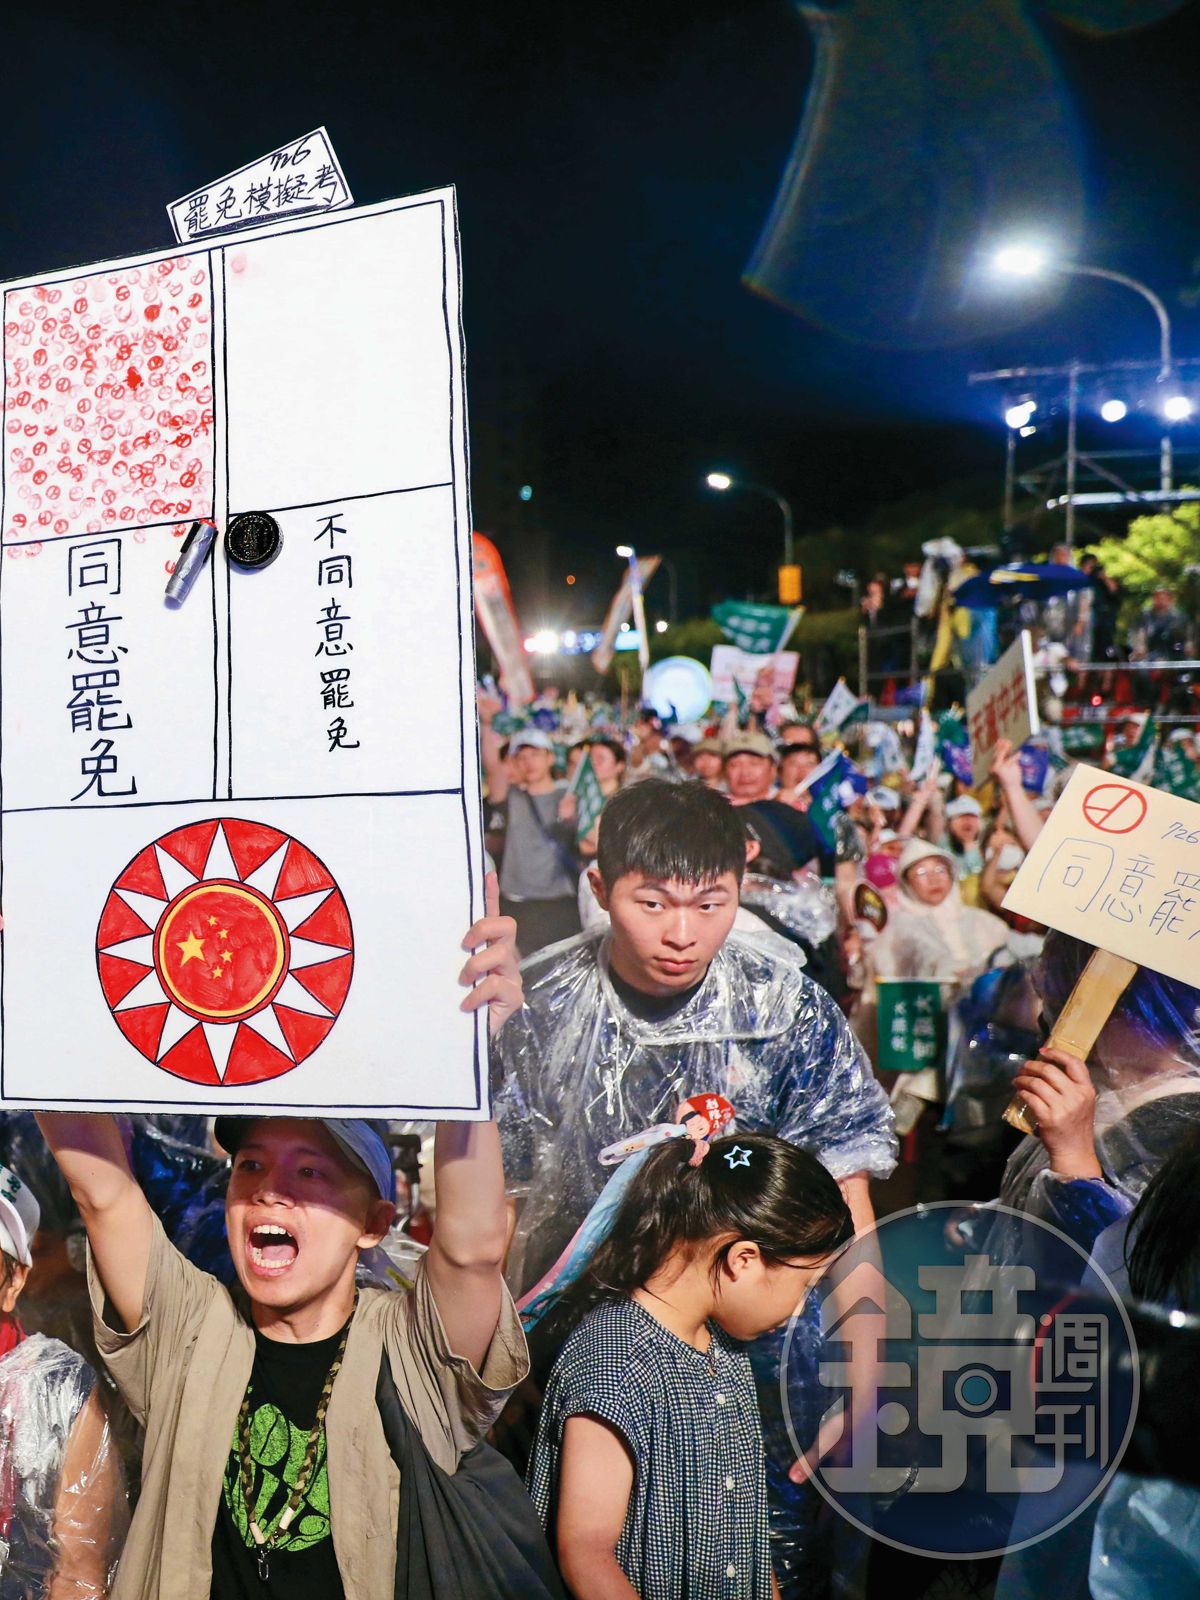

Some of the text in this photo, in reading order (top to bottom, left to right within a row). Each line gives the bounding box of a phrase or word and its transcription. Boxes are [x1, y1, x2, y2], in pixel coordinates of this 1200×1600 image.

[184, 164, 338, 233] 罷免模擬考
[65, 538, 138, 801] 同意罷免
[314, 513, 360, 752] 不同意罷免
[1037, 837, 1200, 941] 同意罷
